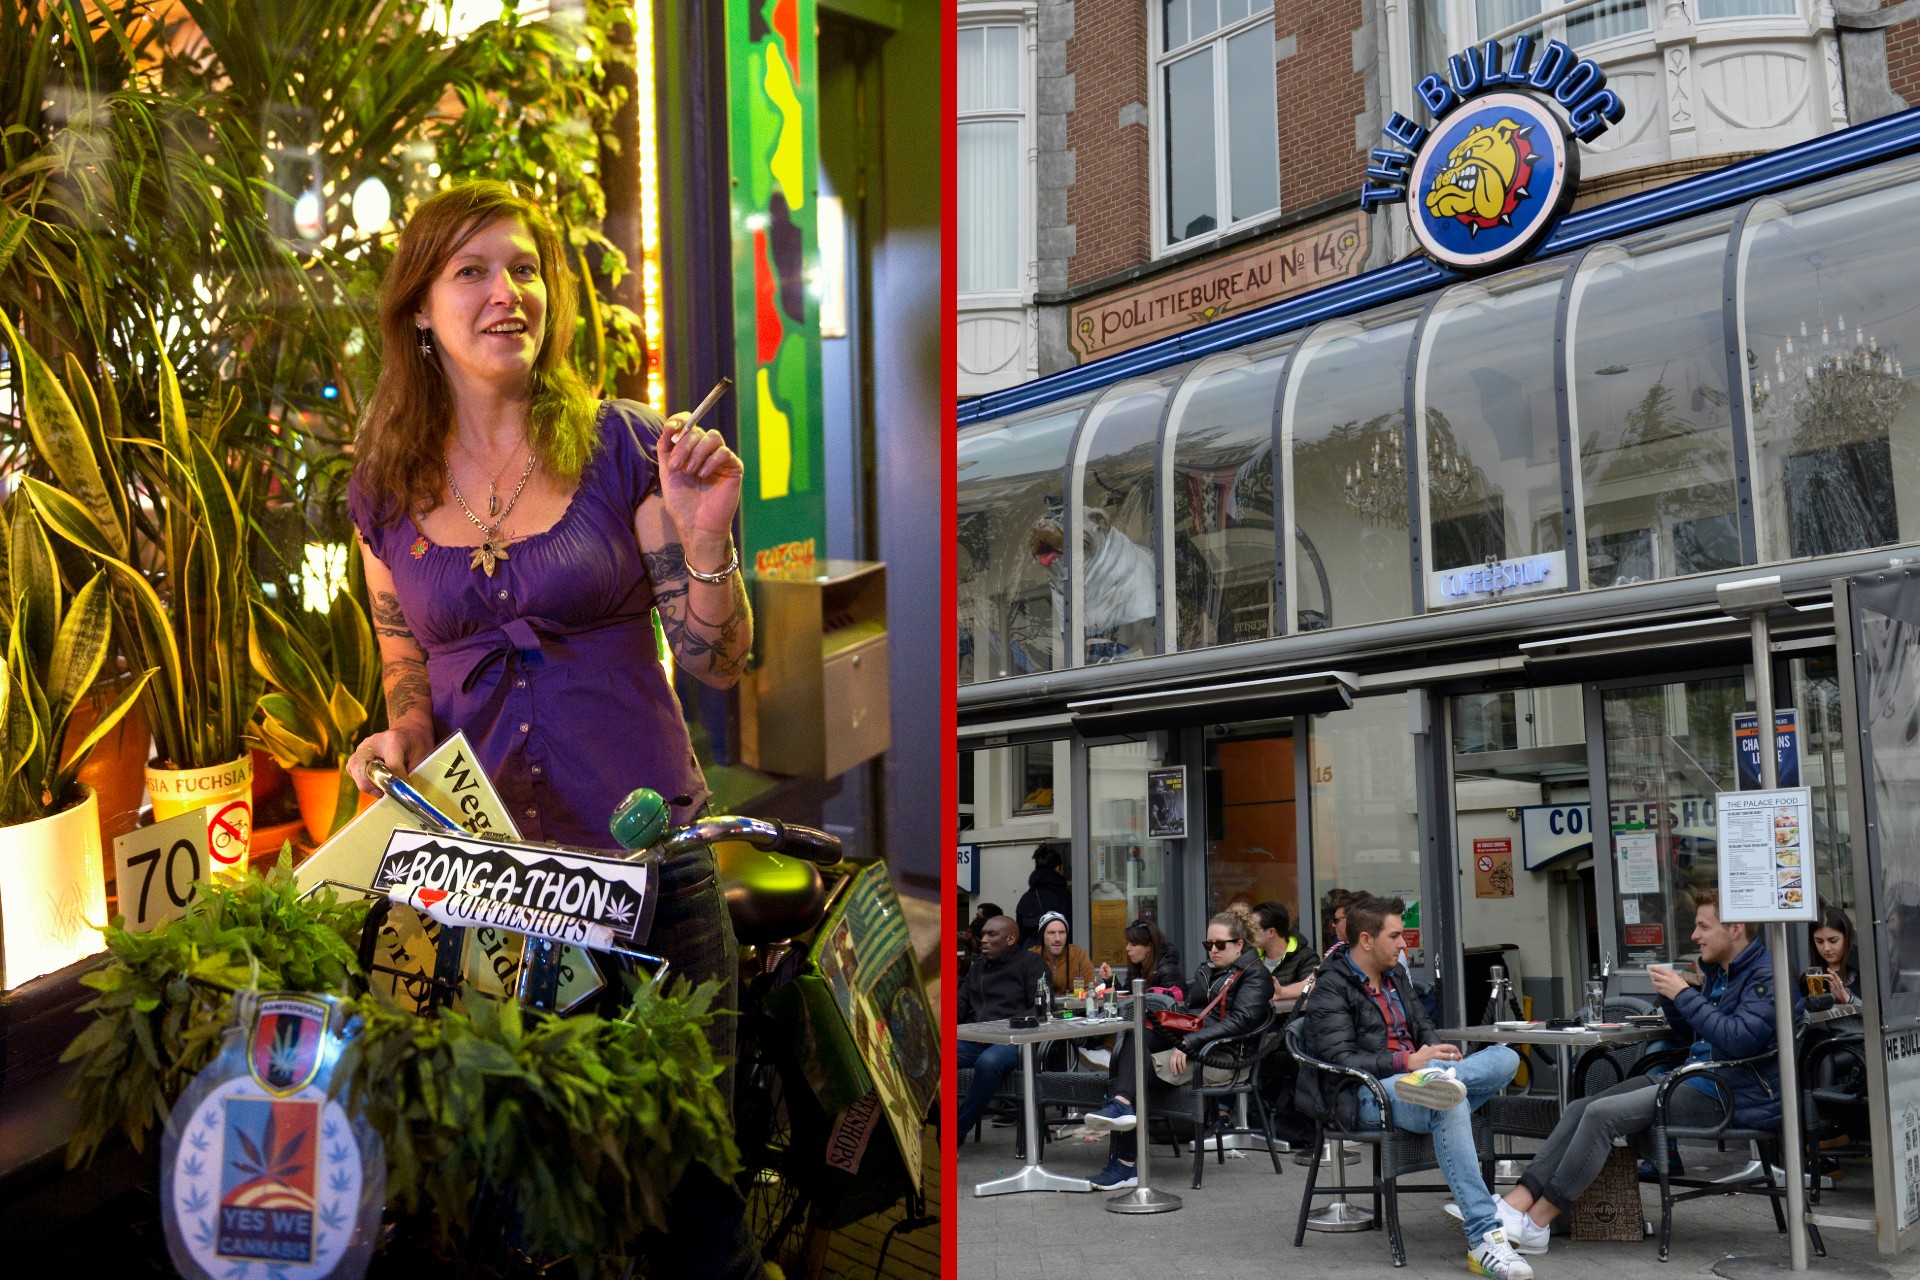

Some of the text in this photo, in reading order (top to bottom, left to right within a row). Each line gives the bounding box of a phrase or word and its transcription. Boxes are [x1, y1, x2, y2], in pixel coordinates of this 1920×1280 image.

[1360, 35, 1626, 214] THE BULLDOG
[1101, 261, 1273, 345] POLITIEBUREAU
[1313, 234, 1337, 276] 14
[1440, 558, 1549, 597] COFFEESHOP
[1742, 735, 1791, 752] CHANS
[1752, 750, 1783, 764] LEE
[176, 769, 246, 793] FUCHSIA
[1315, 765, 1333, 783] 15
[1743, 799, 1774, 807] PALACE
[1775, 797, 1799, 805] FOOD
[1550, 801, 1716, 835] COFEESHO
[127, 839, 200, 923] 70
[406, 850, 612, 920] BONG-A-THON
[446, 892, 590, 942] COFFEESHOPS
[1886, 1037, 1899, 1062] HE
[222, 1208, 311, 1236] YES WE
[1584, 1204, 1625, 1216] Hard Rock
